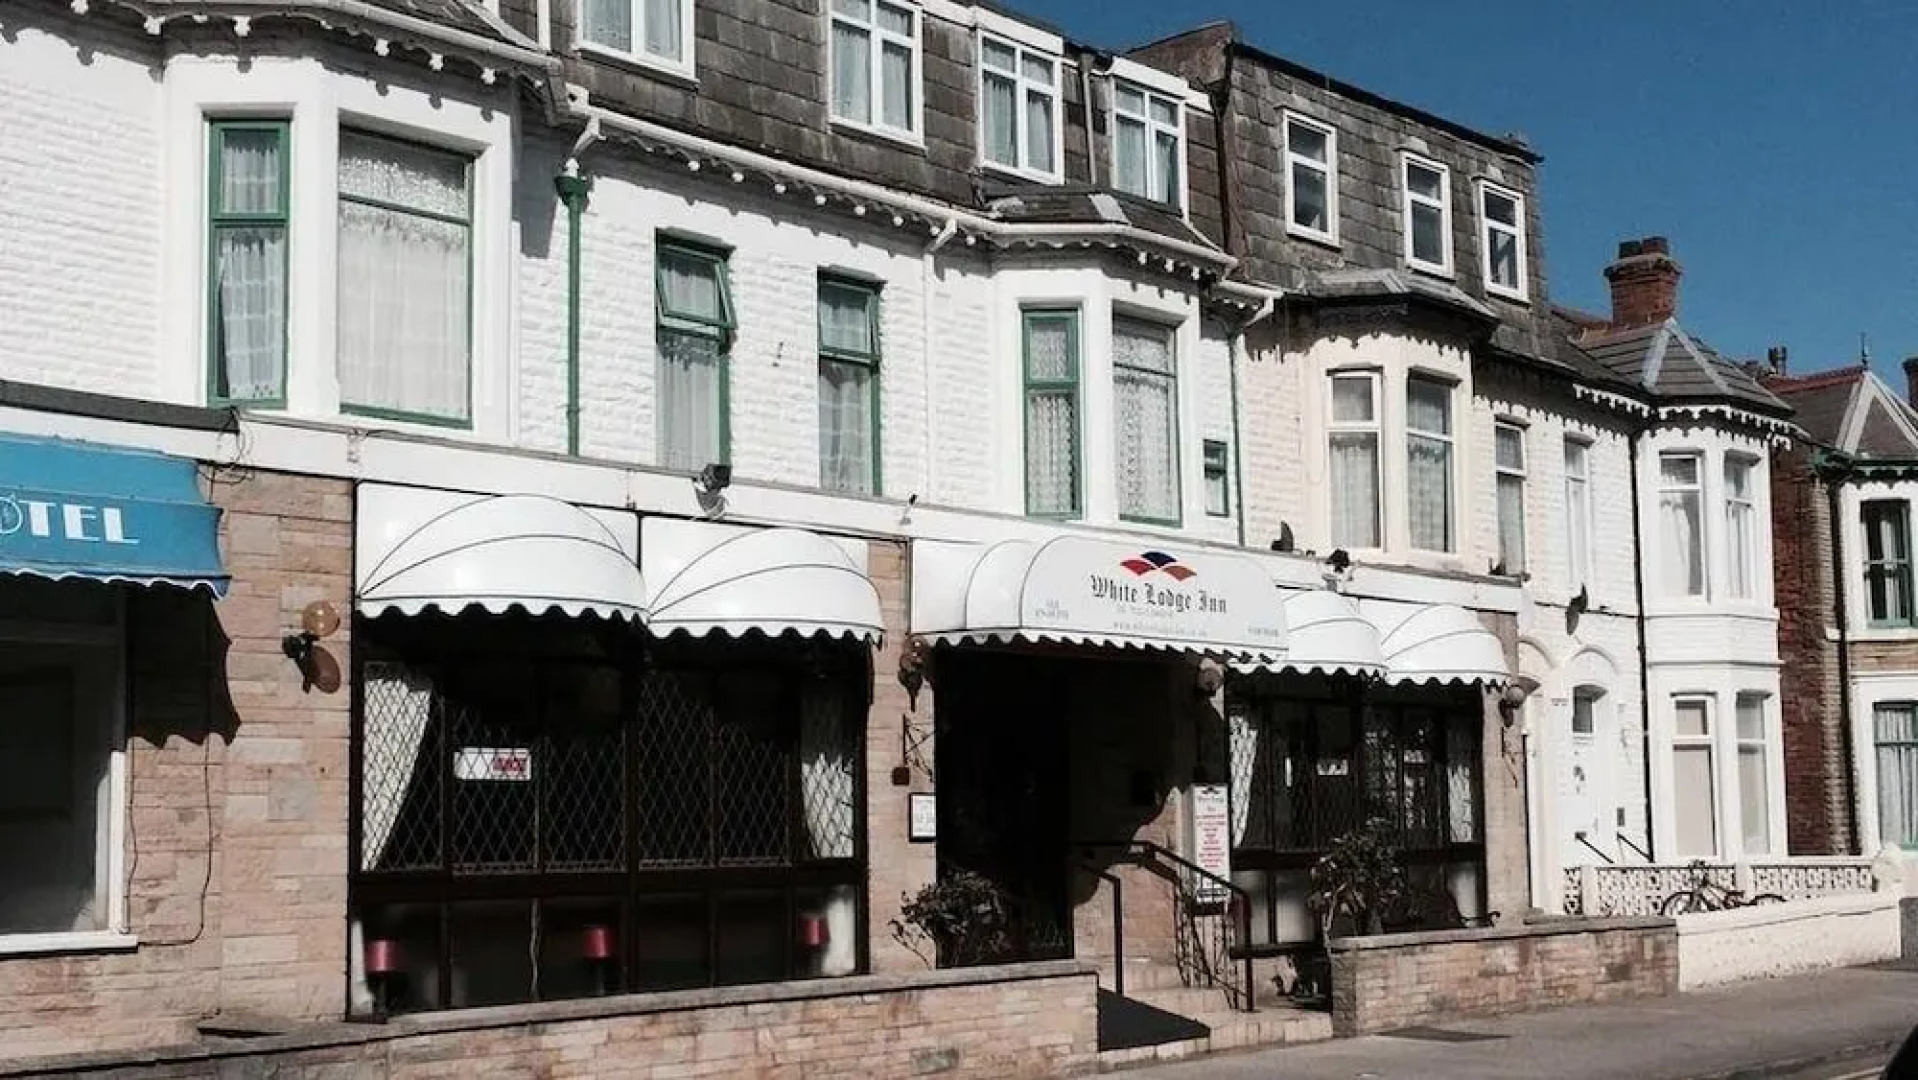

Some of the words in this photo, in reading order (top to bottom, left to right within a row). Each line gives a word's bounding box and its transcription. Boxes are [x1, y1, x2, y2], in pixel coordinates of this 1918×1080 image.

[1090, 574, 1138, 603] White
[1144, 582, 1192, 613] Lodge
[1198, 589, 1227, 613] Inn
